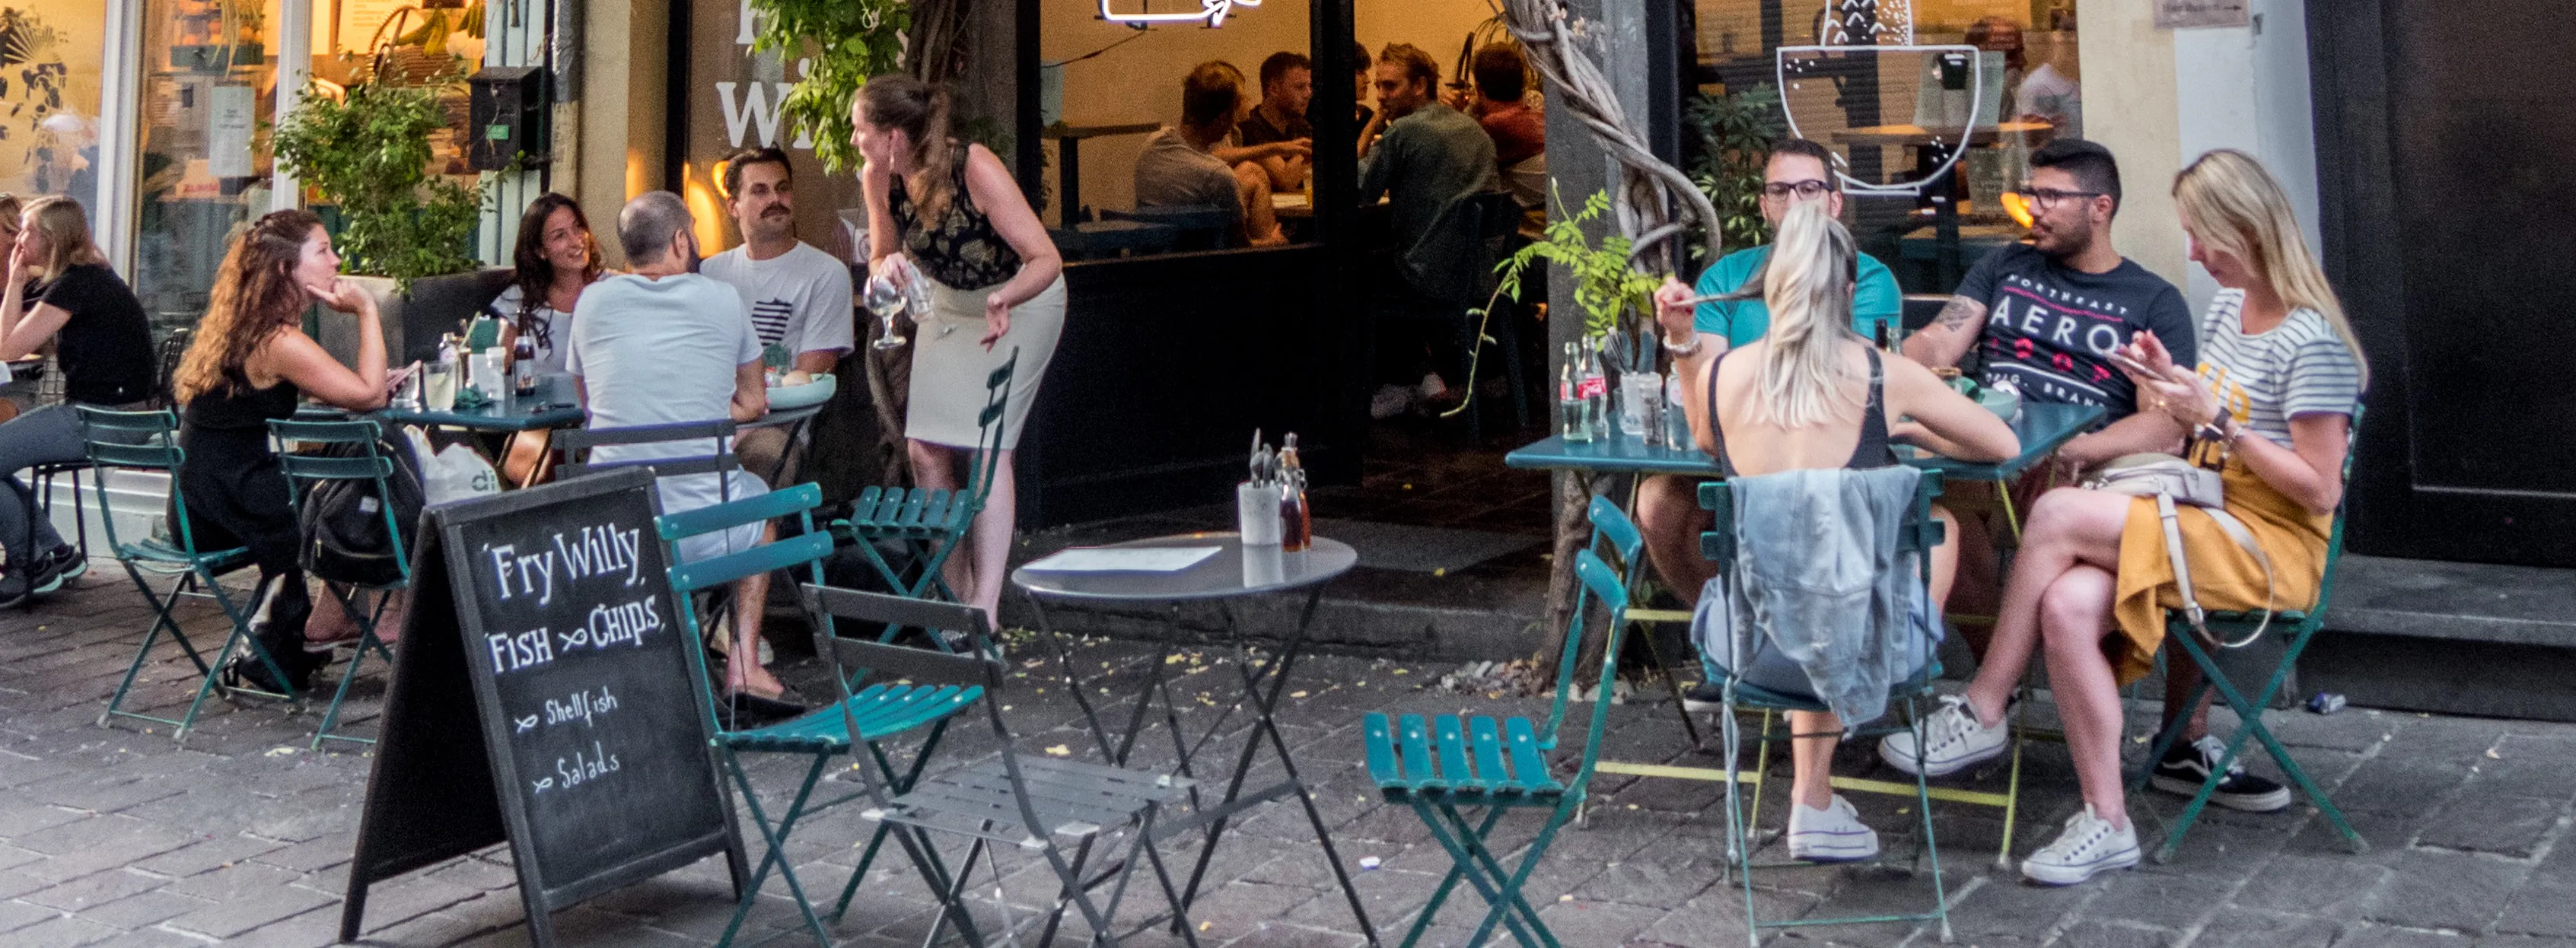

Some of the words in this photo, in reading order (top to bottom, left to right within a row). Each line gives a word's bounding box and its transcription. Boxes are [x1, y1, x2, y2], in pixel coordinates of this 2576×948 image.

[2007, 274, 2128, 315] NORTHEAST
[1989, 294, 2119, 355] AERO
[545, 686, 619, 728] Shellfish
[557, 740, 620, 789] Salads
